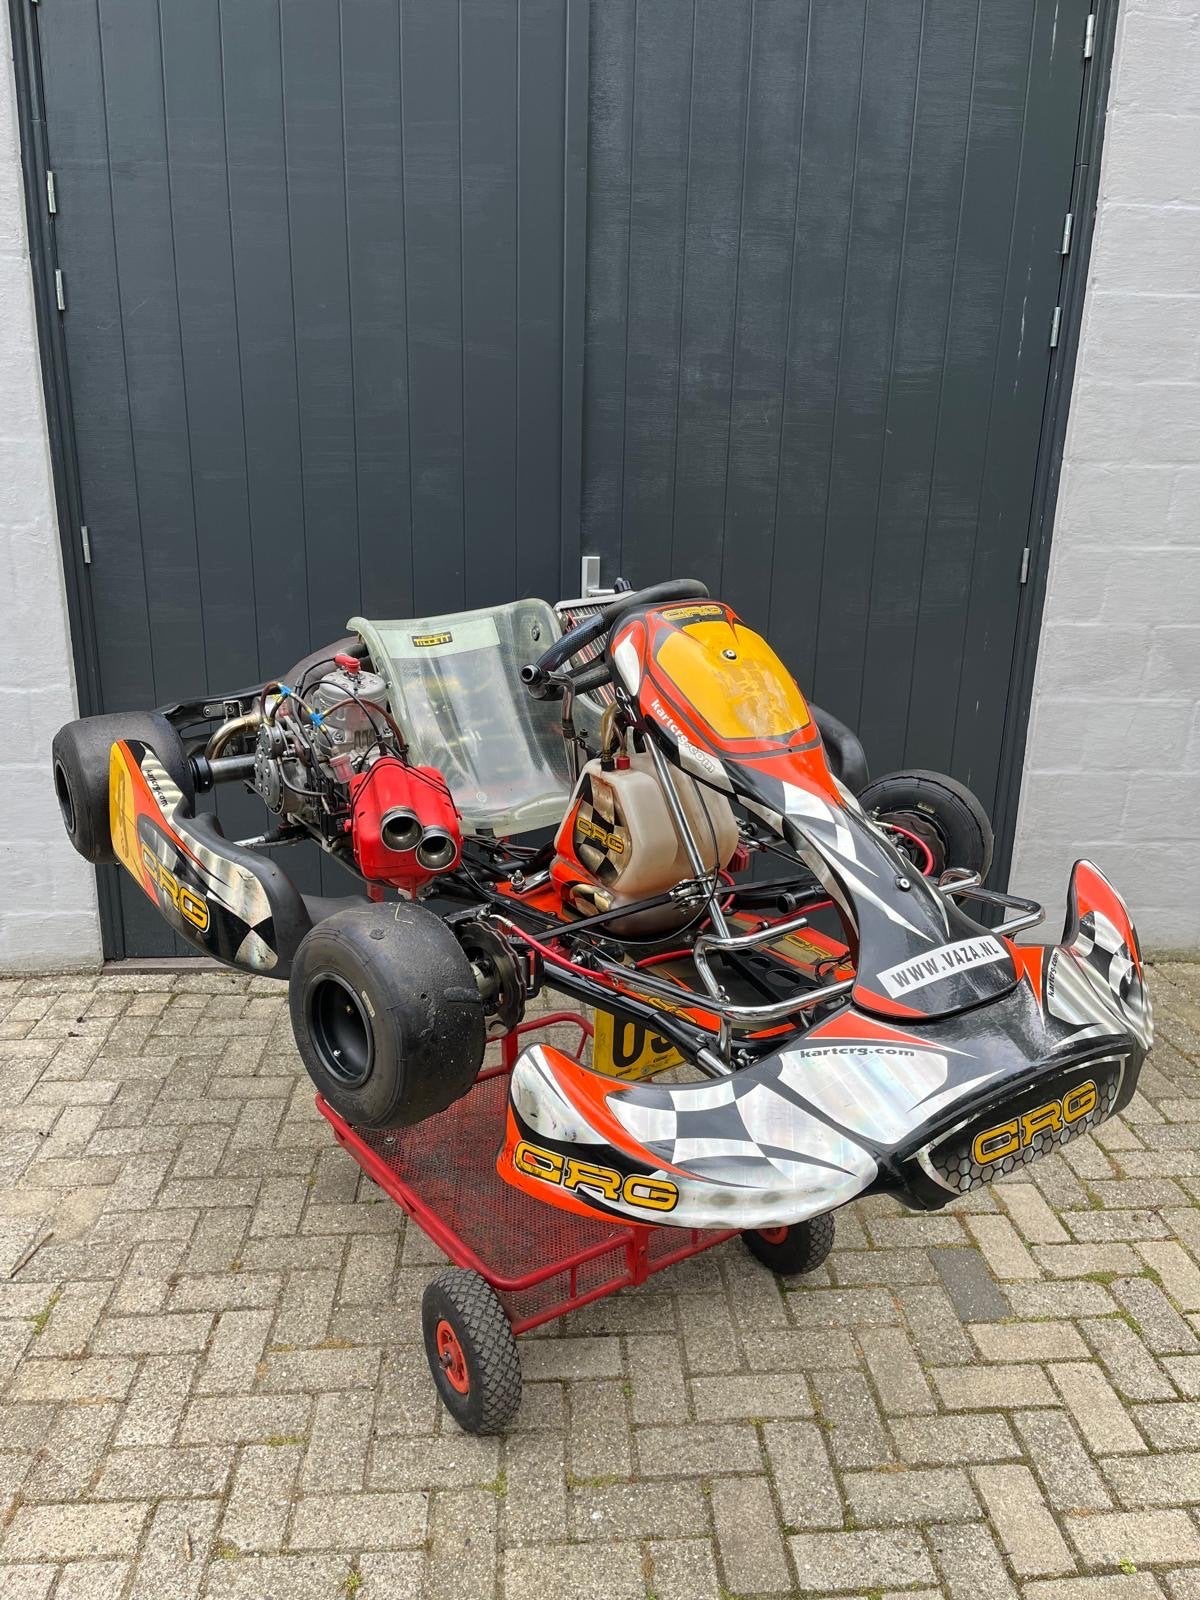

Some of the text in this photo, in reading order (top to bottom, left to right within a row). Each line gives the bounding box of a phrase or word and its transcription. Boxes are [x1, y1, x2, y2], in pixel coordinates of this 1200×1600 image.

[651, 699, 716, 774] kartcrg.com
[577, 816, 625, 855] CRG
[141, 842, 211, 933] CRG
[891, 940, 1000, 989] WWW.VAZA.NL
[1047, 952, 1060, 998] kartcrg.com
[800, 1047, 915, 1059] kartcrg.com
[972, 1079, 1098, 1168] CRG
[513, 1139, 680, 1213] CRG
